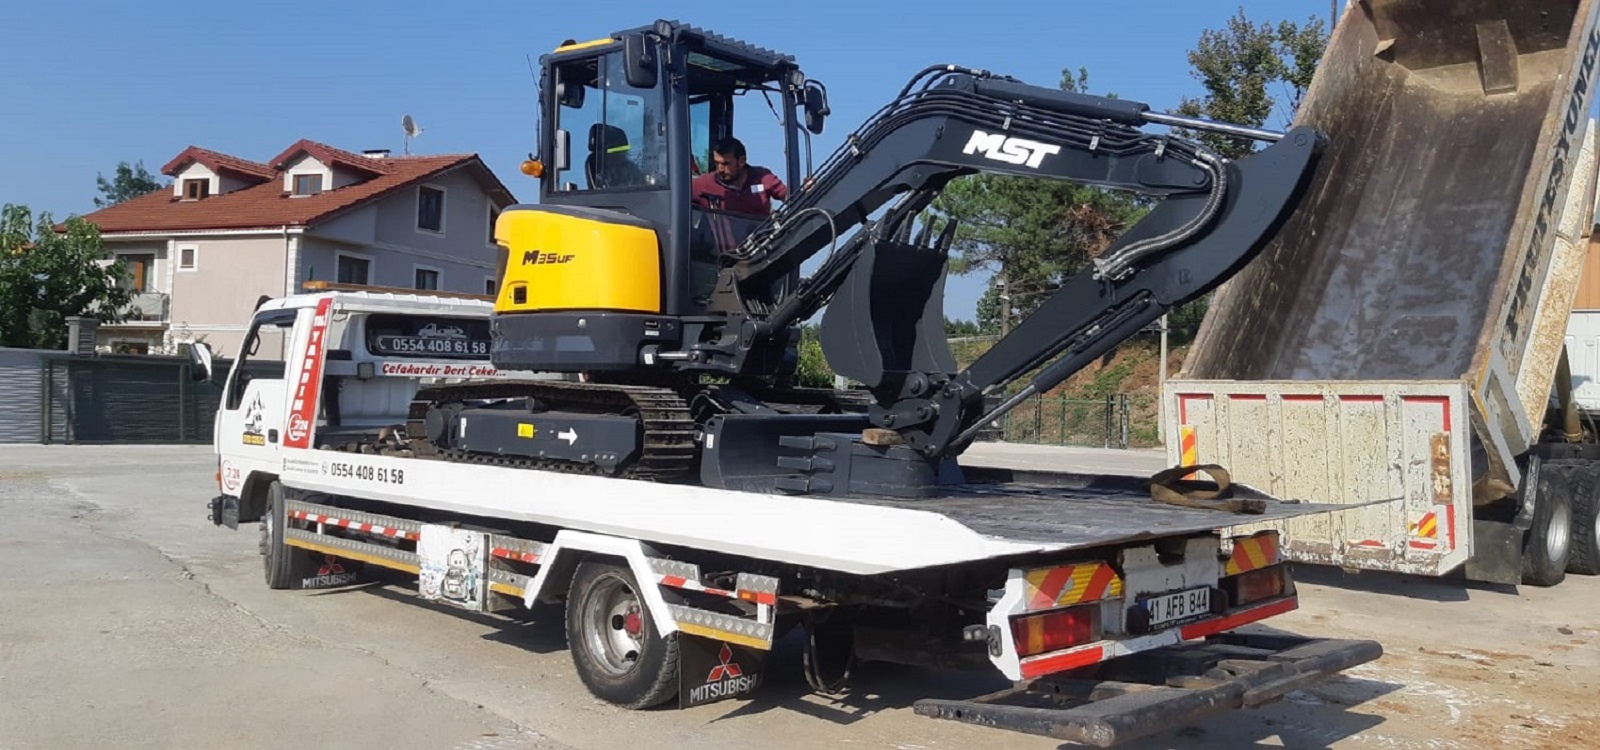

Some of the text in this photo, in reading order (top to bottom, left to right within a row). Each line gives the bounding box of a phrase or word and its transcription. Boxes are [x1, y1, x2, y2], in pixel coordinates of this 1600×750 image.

[962, 129, 1061, 169] MST
[393, 338, 486, 354] 0554 408 61 58
[444, 365, 466, 375] Dert
[331, 462, 353, 478] 0554
[355, 465, 374, 481] 408
[377, 467, 388, 483] 61
[391, 468, 404, 485] 58
[302, 571, 357, 589] MITSUBISHI
[1149, 588, 1207, 621] 41 AFB 844
[690, 673, 757, 704] MITSUBISHI
